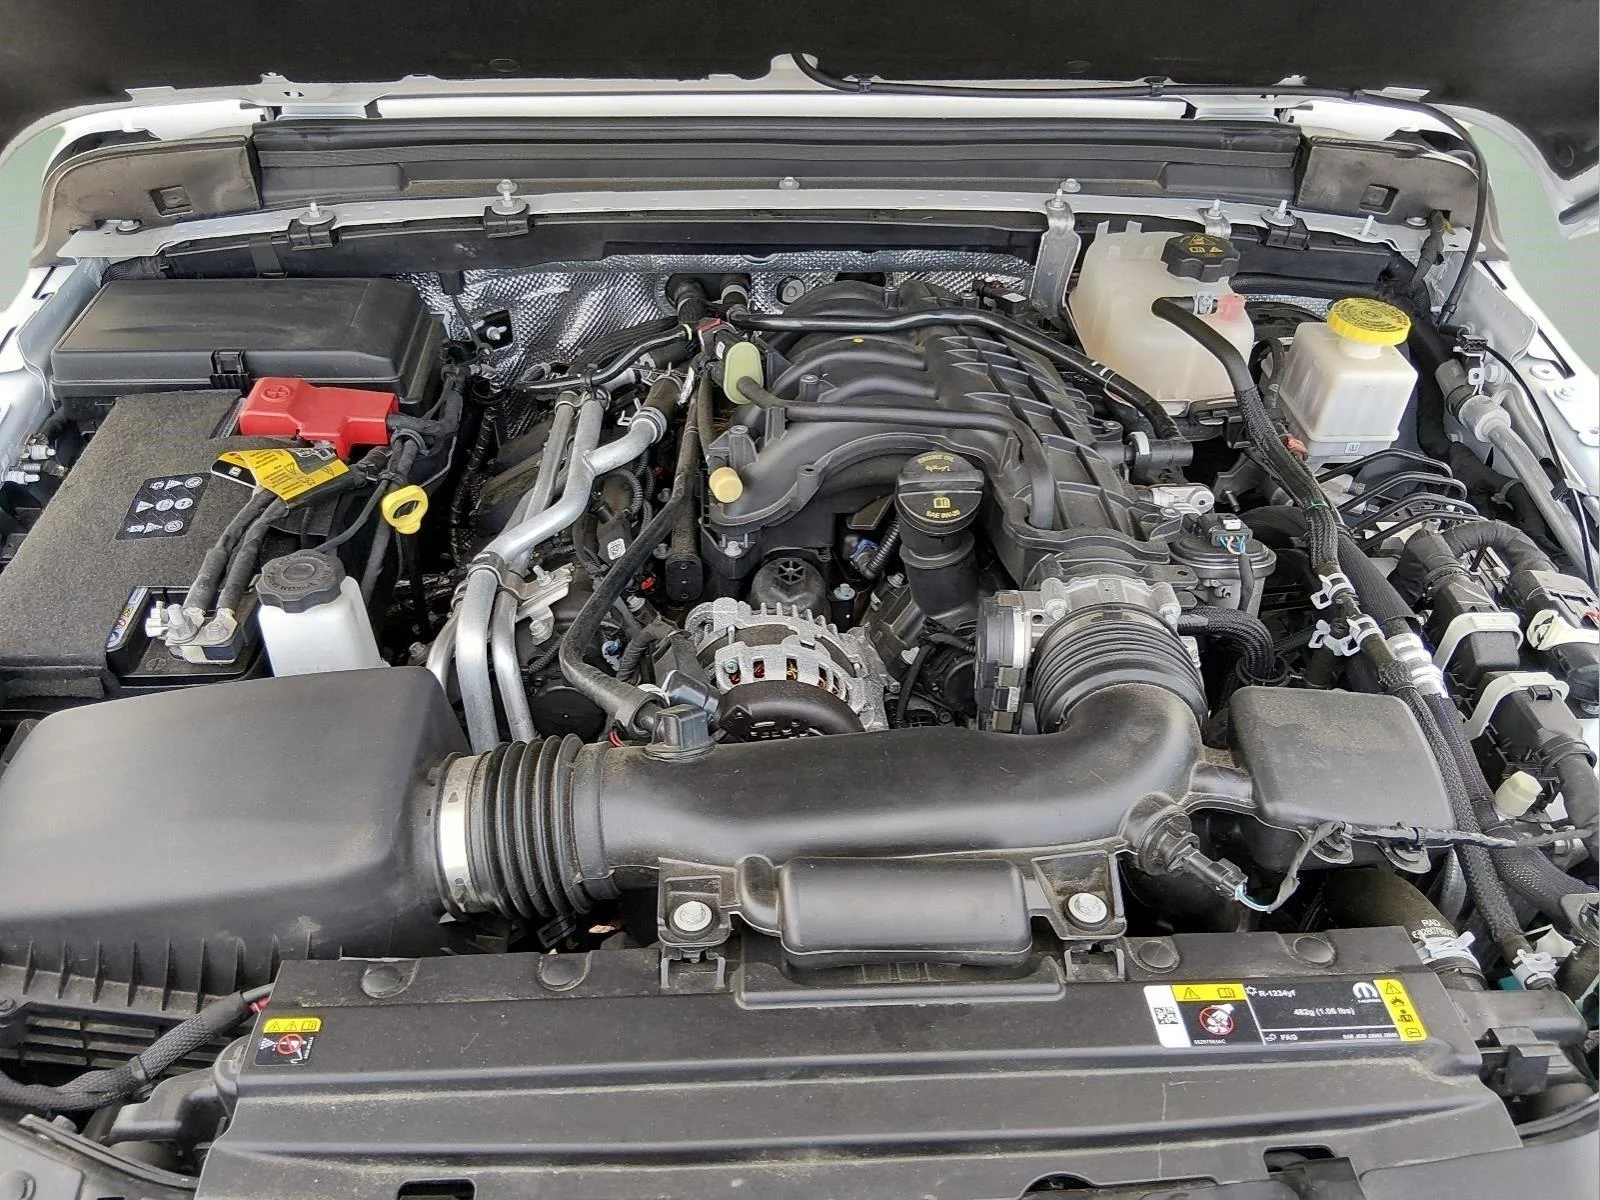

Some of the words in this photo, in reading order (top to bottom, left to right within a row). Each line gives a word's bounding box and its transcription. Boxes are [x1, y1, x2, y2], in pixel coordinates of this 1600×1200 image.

[917, 454, 943, 463] ENGINE
[943, 455, 955, 463] OIL
[926, 510, 940, 519] SAE
[1420, 919, 1441, 927] RAD
[1258, 989, 1296, 998] R-1234yf
[1293, 1008, 1316, 1017] 482g
